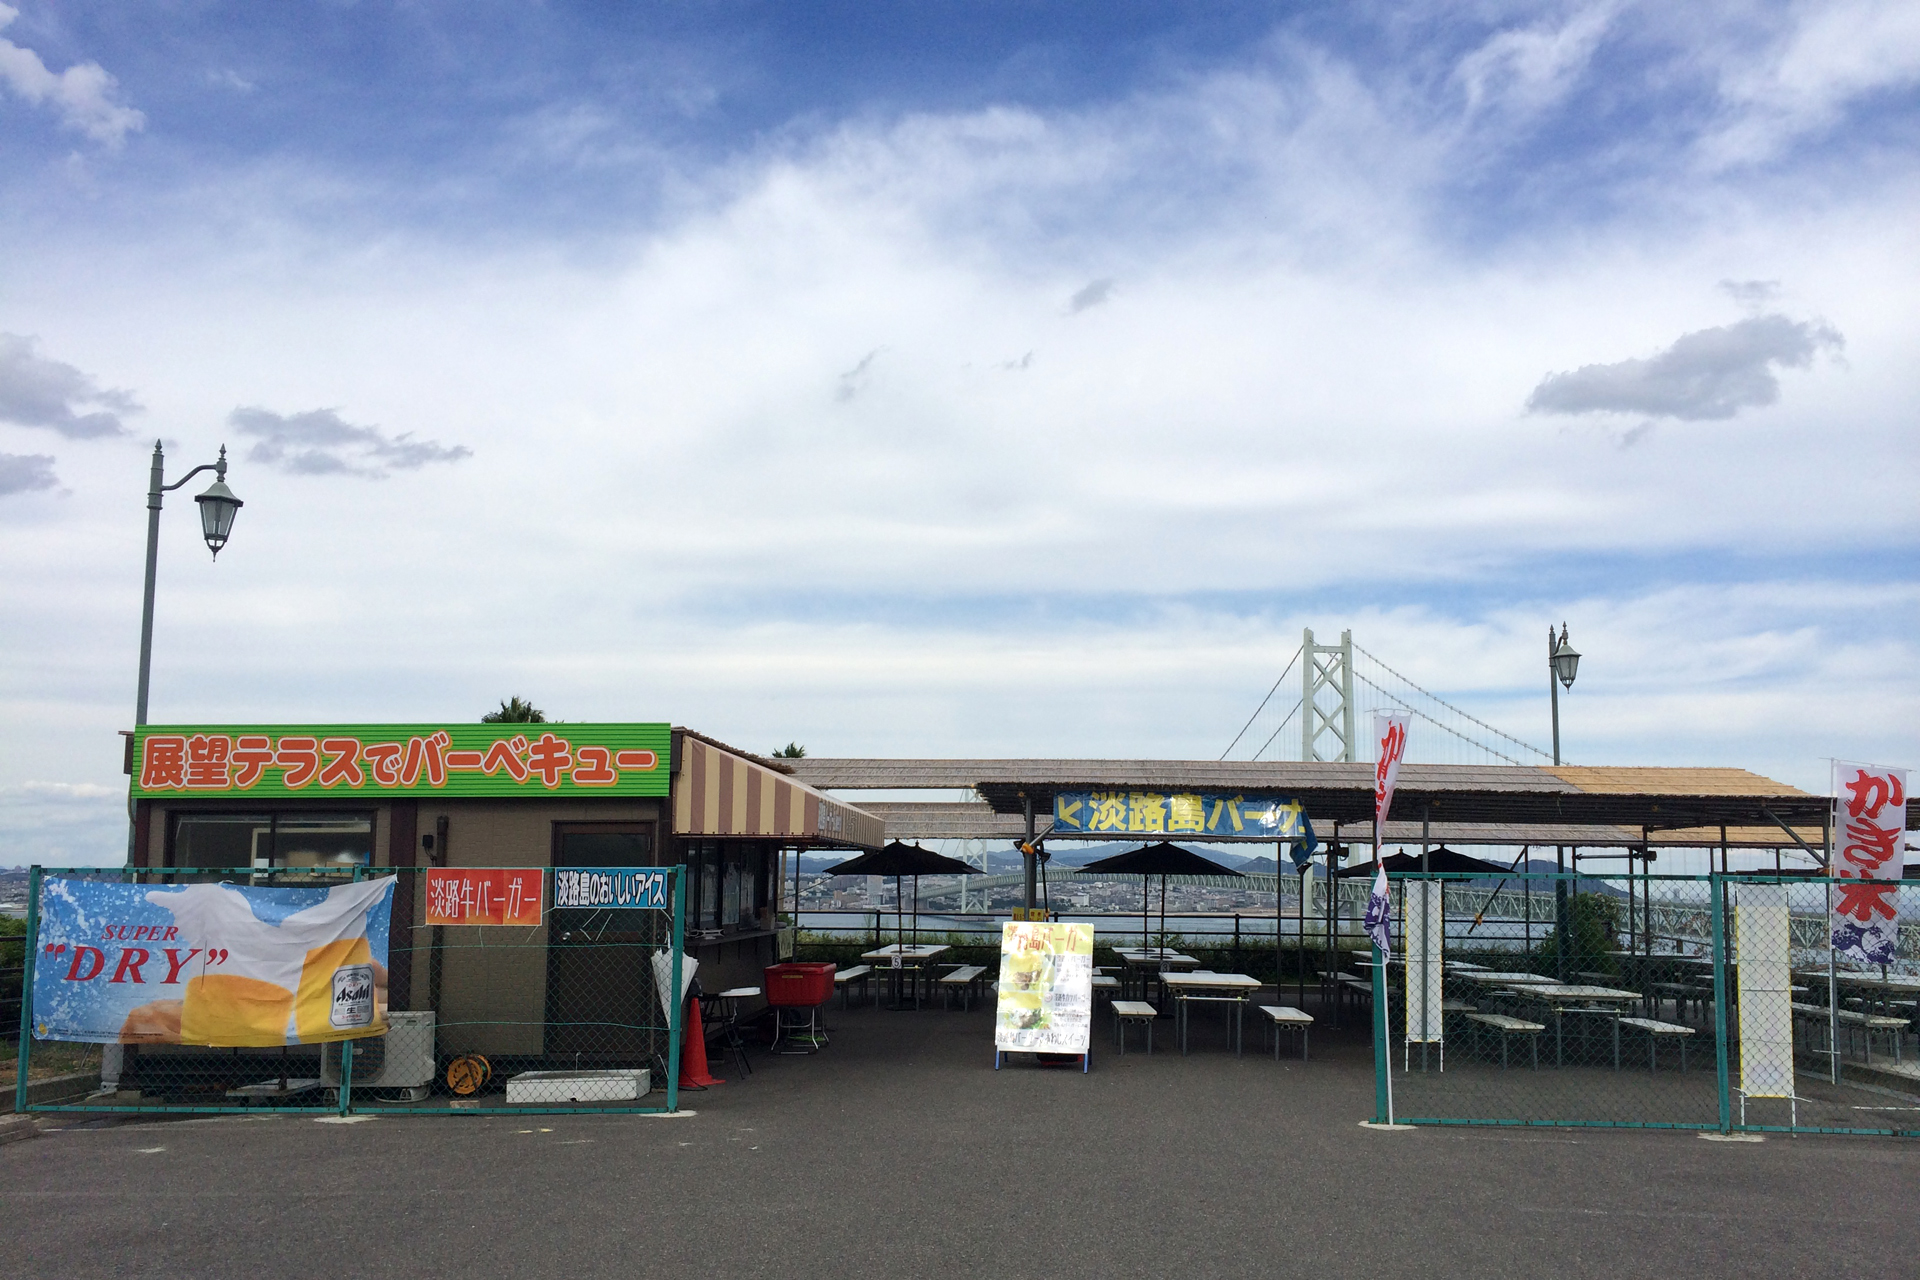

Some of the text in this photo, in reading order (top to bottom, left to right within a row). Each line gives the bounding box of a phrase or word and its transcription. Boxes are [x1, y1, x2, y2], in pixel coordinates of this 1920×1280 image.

[140, 730, 658, 790] 展望テラスでバーベキュー
[1836, 769, 1904, 922] かき氷
[430, 877, 537, 919] 淡路牛バーガー
[557, 870, 665, 907] 淡路島のおいしいアイス
[101, 924, 179, 941] SUPER
[336, 983, 370, 1003] Asahi
[346, 1006, 357, 1015] 生
